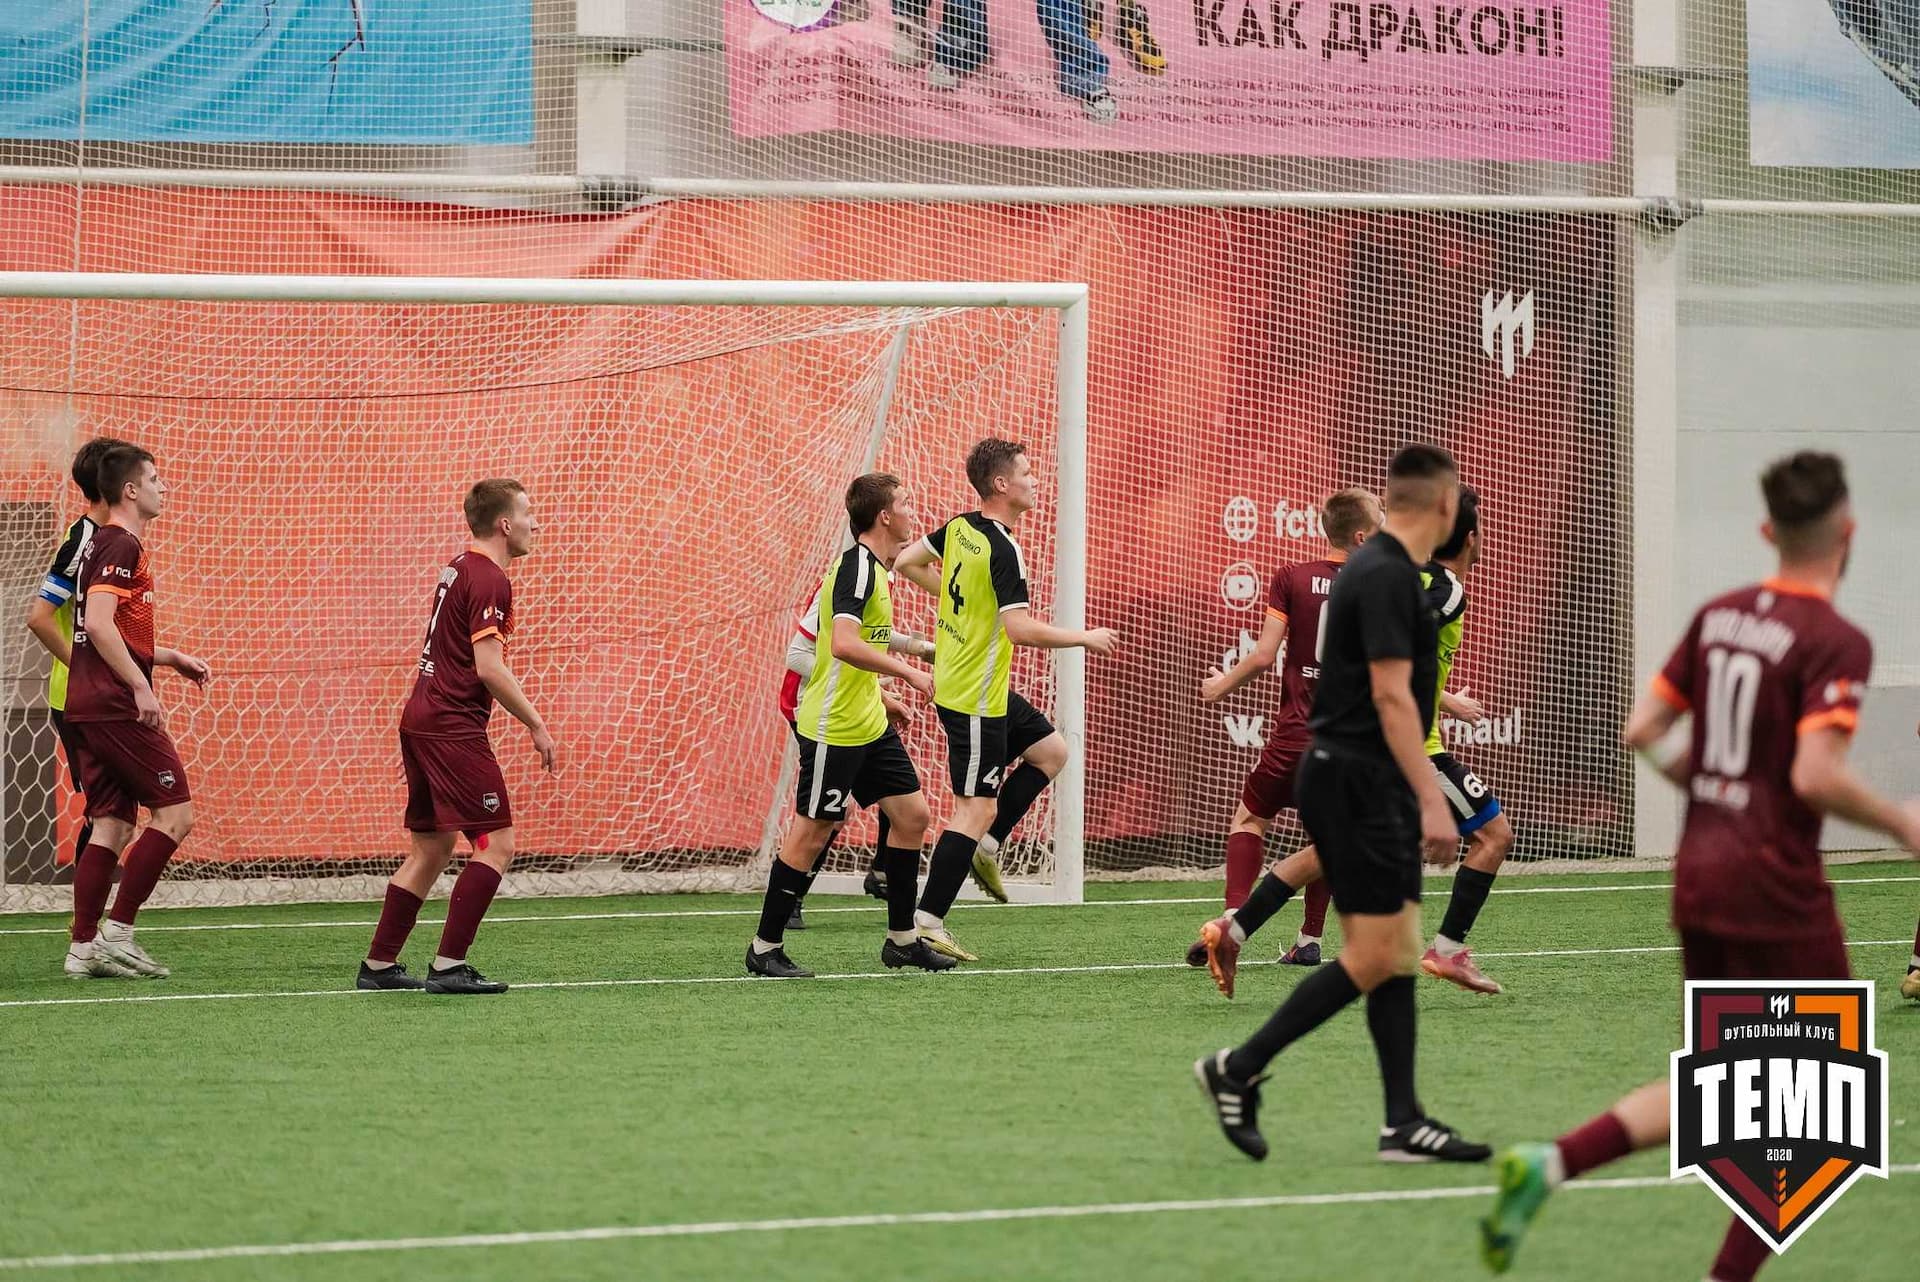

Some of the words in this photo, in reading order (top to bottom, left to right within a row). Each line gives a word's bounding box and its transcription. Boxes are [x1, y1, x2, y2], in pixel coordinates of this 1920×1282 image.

[1193, 0, 1306, 50] КАК
[1322, 3, 1564, 62] ДРАКОН!
[948, 561, 965, 615] 4
[1443, 706, 1521, 744] rnaul
[1702, 647, 1762, 777] 10
[982, 766, 1000, 789] 4
